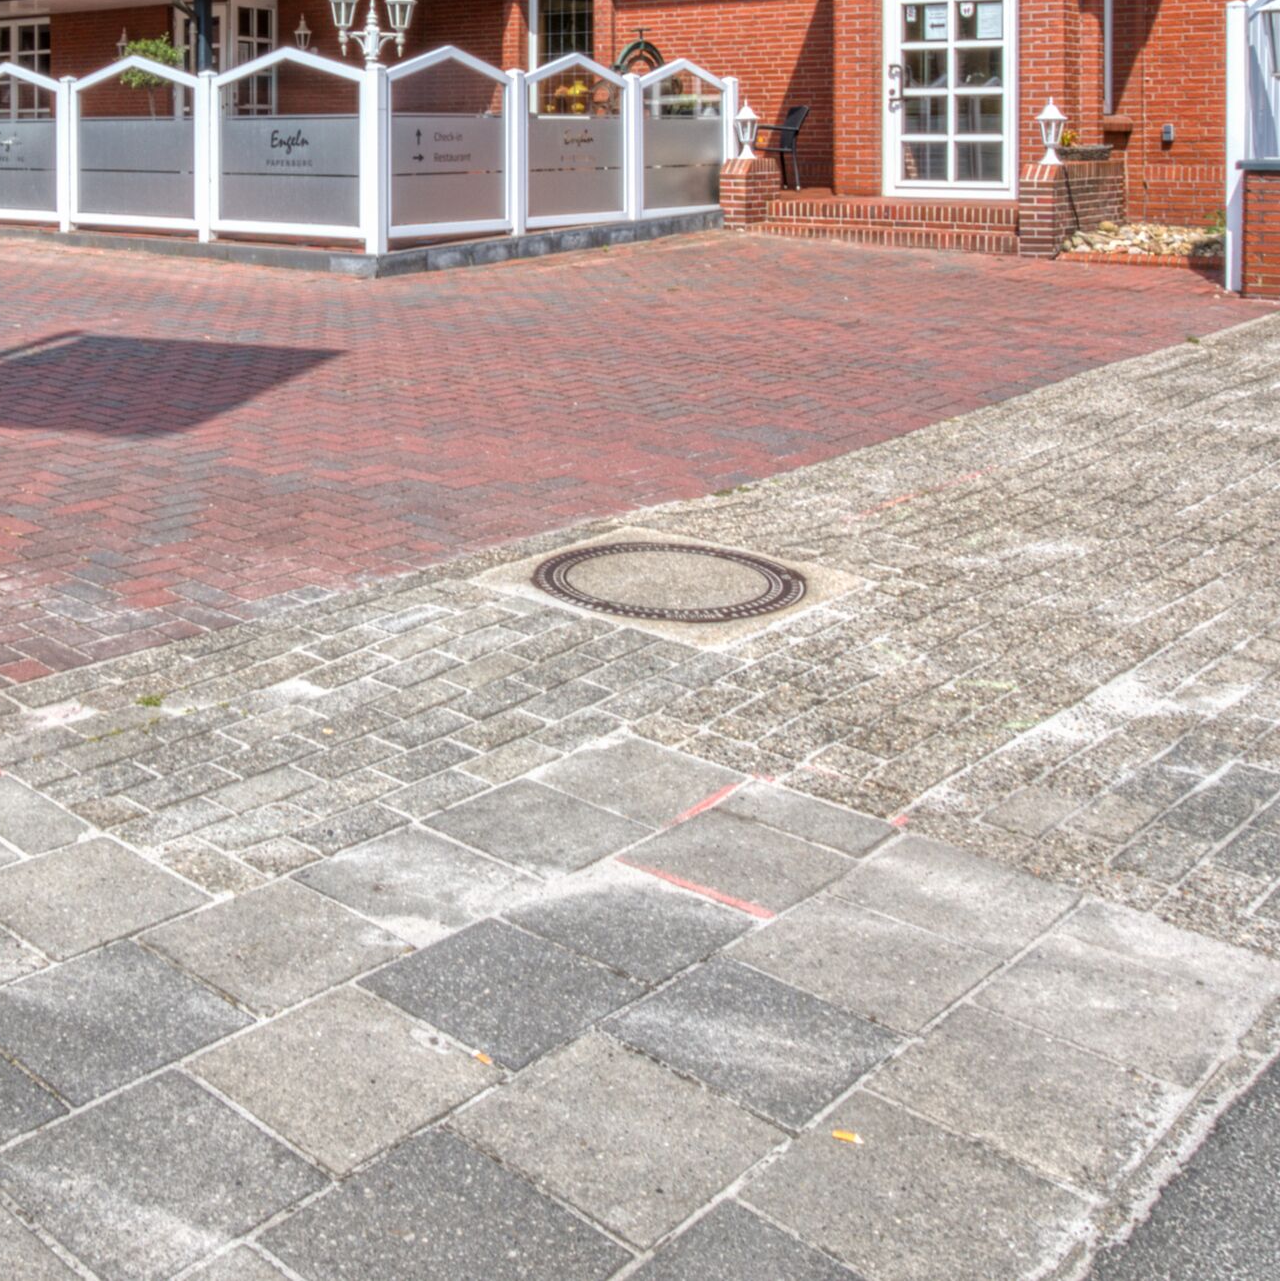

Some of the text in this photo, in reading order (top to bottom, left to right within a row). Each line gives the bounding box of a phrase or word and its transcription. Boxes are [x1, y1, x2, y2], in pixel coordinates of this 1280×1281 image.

[270, 128, 310, 155] Engeln
[434, 132, 463, 143] Check-in
[433, 152, 471, 163] Restaurant
